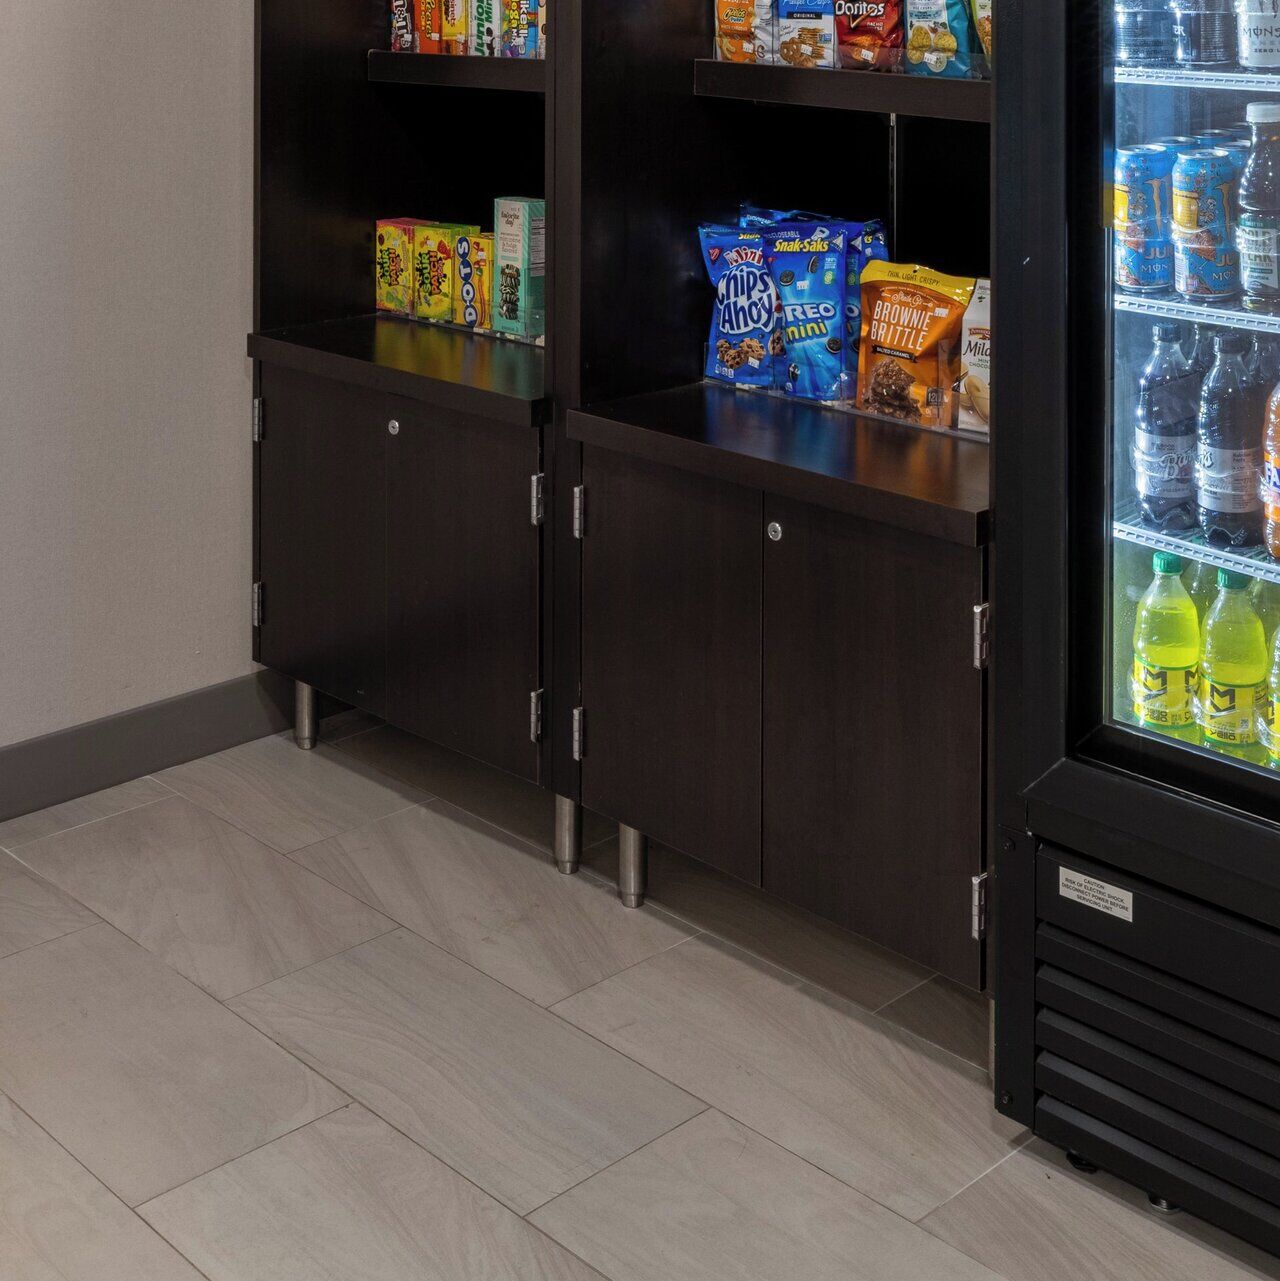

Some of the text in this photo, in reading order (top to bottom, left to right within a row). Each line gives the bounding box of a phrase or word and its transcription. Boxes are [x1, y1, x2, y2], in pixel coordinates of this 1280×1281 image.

[835, 0, 885, 17] Doritos
[389, 248, 399, 286] PATCH
[724, 246, 763, 266] Mini
[421, 250, 442, 296] SOUR PATCH
[717, 266, 771, 306] Chips
[919, 276, 940, 285] CRISPY
[721, 293, 773, 333] Ahoy
[874, 300, 933, 330] BROWNIE
[871, 321, 928, 350] BRITTLE
[891, 349, 910, 358] CARAMEL
[1084, 879, 1105, 890] CAUTION
